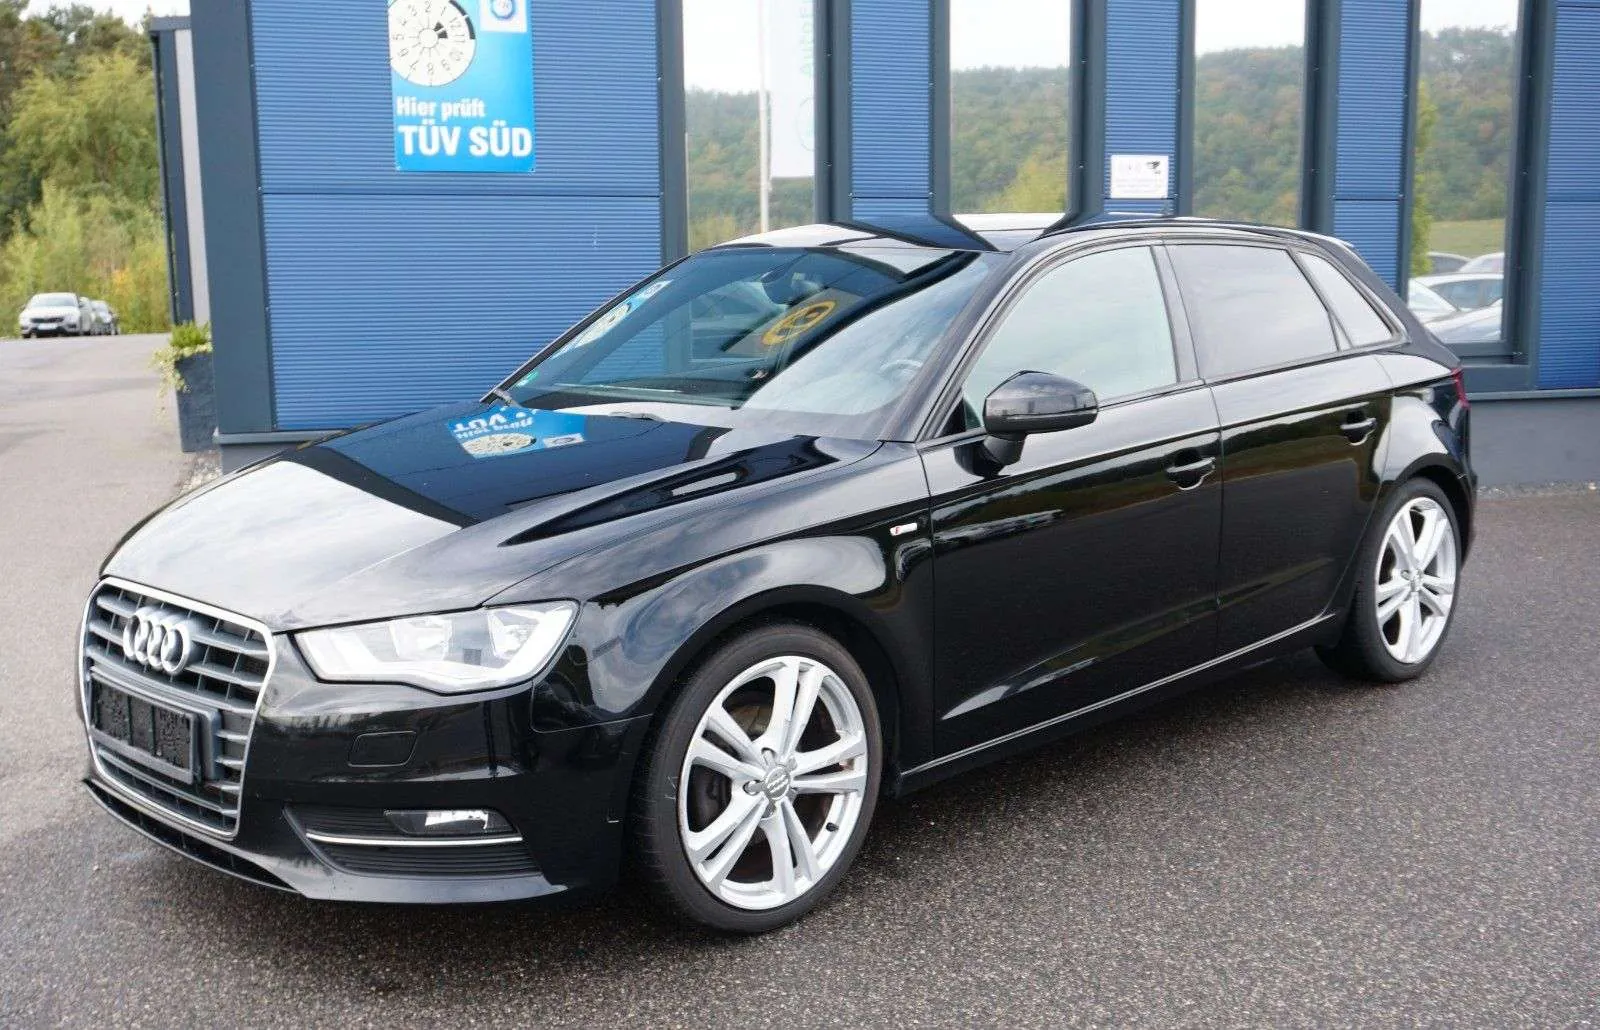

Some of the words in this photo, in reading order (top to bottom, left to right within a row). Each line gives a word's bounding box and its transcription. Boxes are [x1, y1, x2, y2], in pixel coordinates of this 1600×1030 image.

[396, 96, 436, 116] Hier
[441, 97, 485, 121] prüft
[398, 119, 462, 156] TÜV
[469, 120, 532, 157] SÜD
